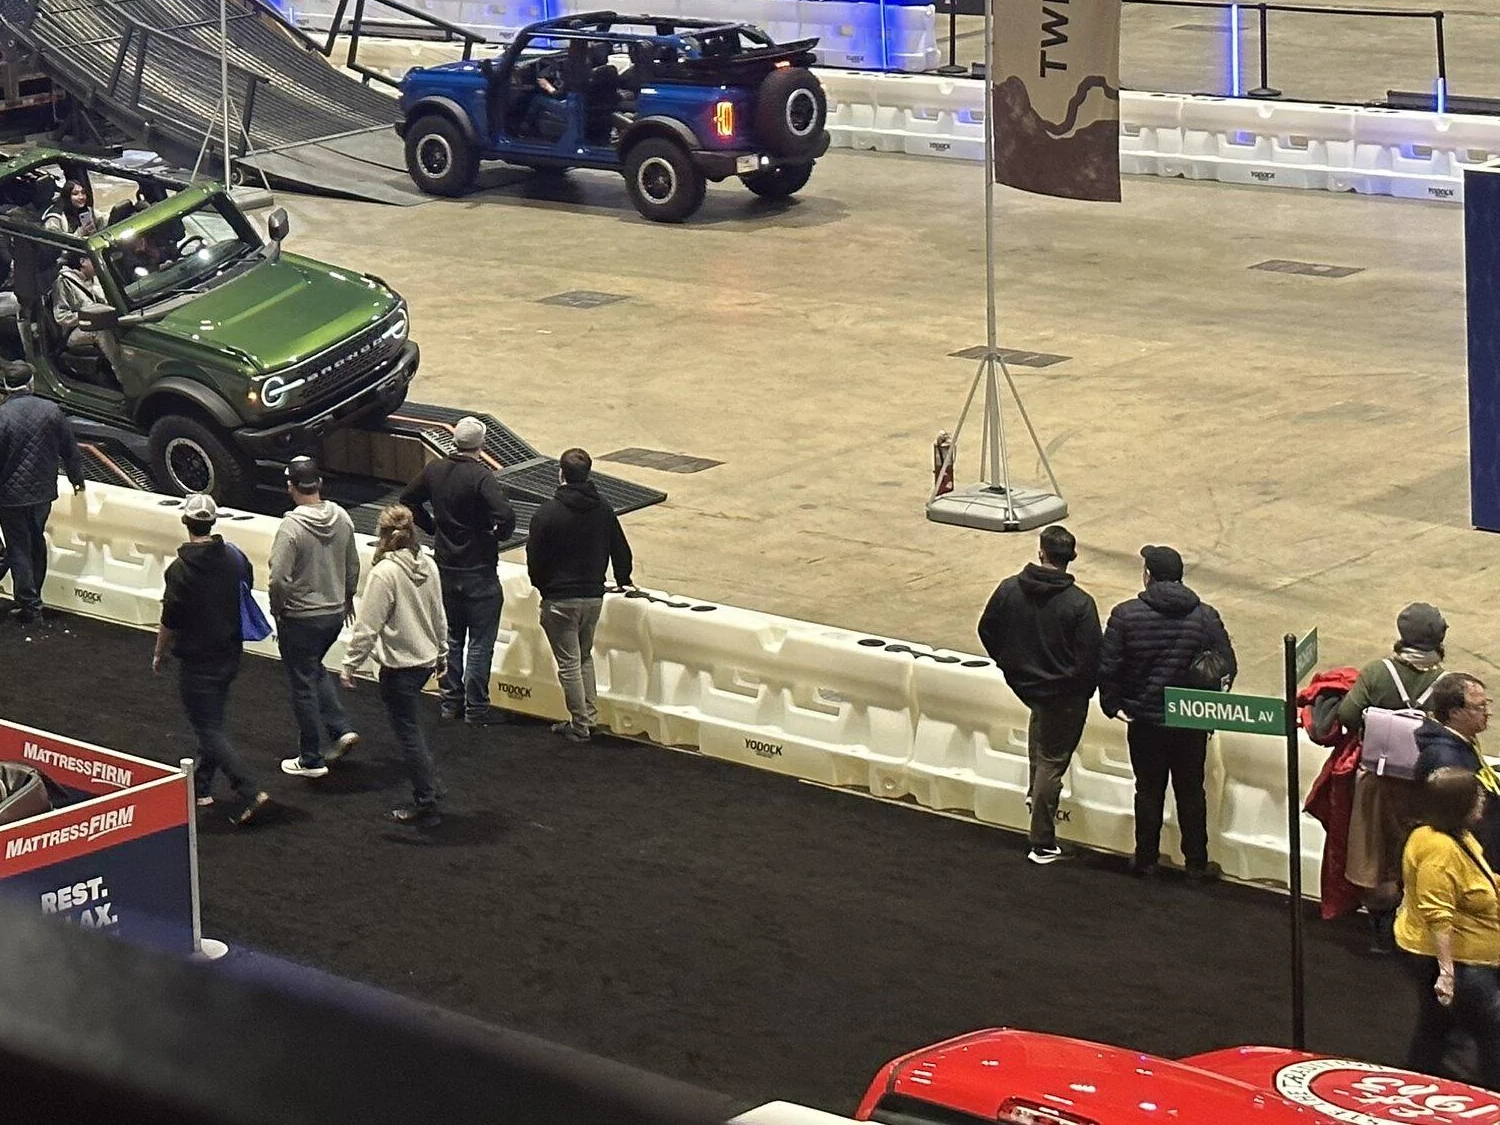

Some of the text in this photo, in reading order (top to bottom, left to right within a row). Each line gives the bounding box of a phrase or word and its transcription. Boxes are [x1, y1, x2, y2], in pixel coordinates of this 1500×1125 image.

[74, 588, 102, 603] YODOCK
[497, 683, 532, 699] YODOCK
[1168, 699, 1274, 723] S NORMAL AV
[745, 738, 783, 756] YODOCK
[41, 876, 108, 915] REST.
